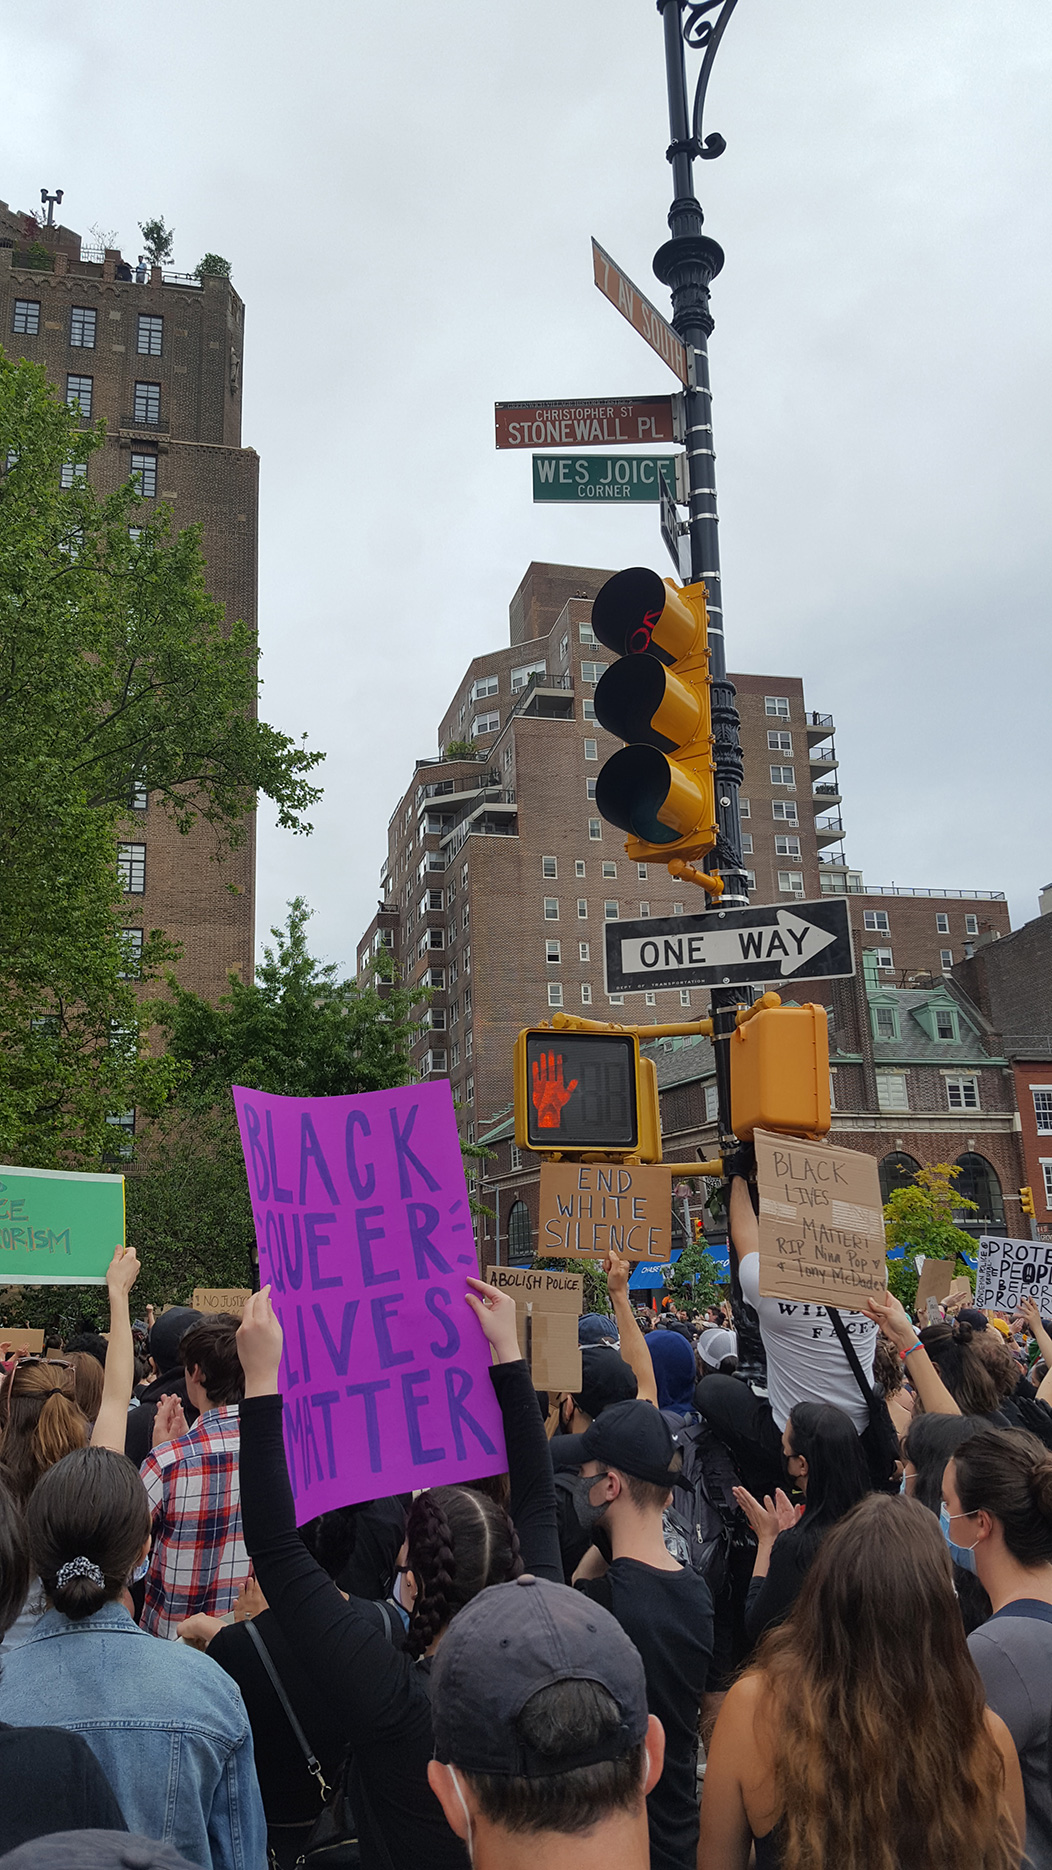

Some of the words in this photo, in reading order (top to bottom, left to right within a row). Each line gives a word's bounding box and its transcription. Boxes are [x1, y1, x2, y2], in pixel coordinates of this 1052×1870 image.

[600, 256, 610, 293] 7
[618, 277, 634, 321] AV
[641, 302, 684, 379] SOUTH
[536, 407, 614, 421] CHRISTOPHER
[620, 406, 634, 418] ST
[508, 418, 628, 445] STONEWALL
[637, 416, 664, 438] PL
[537, 460, 590, 484] WES
[600, 460, 671, 484] JOICE
[577, 485, 631, 497] CORNER
[639, 936, 706, 968] ONE
[738, 926, 811, 960] WAY
[651, 979, 706, 987] TRANSPORTATION
[243, 1101, 442, 1206] BLACK
[772, 1151, 849, 1185] BLACK
[577, 1167, 633, 1194] END
[785, 1184, 829, 1207] LIVES
[556, 1194, 648, 1221] WHITE
[0, 1225, 71, 1256] ORISM
[266, 1202, 455, 1293] QUEER
[544, 1219, 665, 1258] SILENCE
[802, 1217, 870, 1253] MATTER!
[776, 1236, 805, 1256] RIP
[815, 1245, 841, 1263] Nina
[846, 1249, 868, 1272] Pop
[490, 1271, 542, 1290] ABOLISH
[203, 1295, 220, 1308] NO
[279, 1286, 461, 1391] LIVES
[284, 1366, 498, 1499] MATTER
